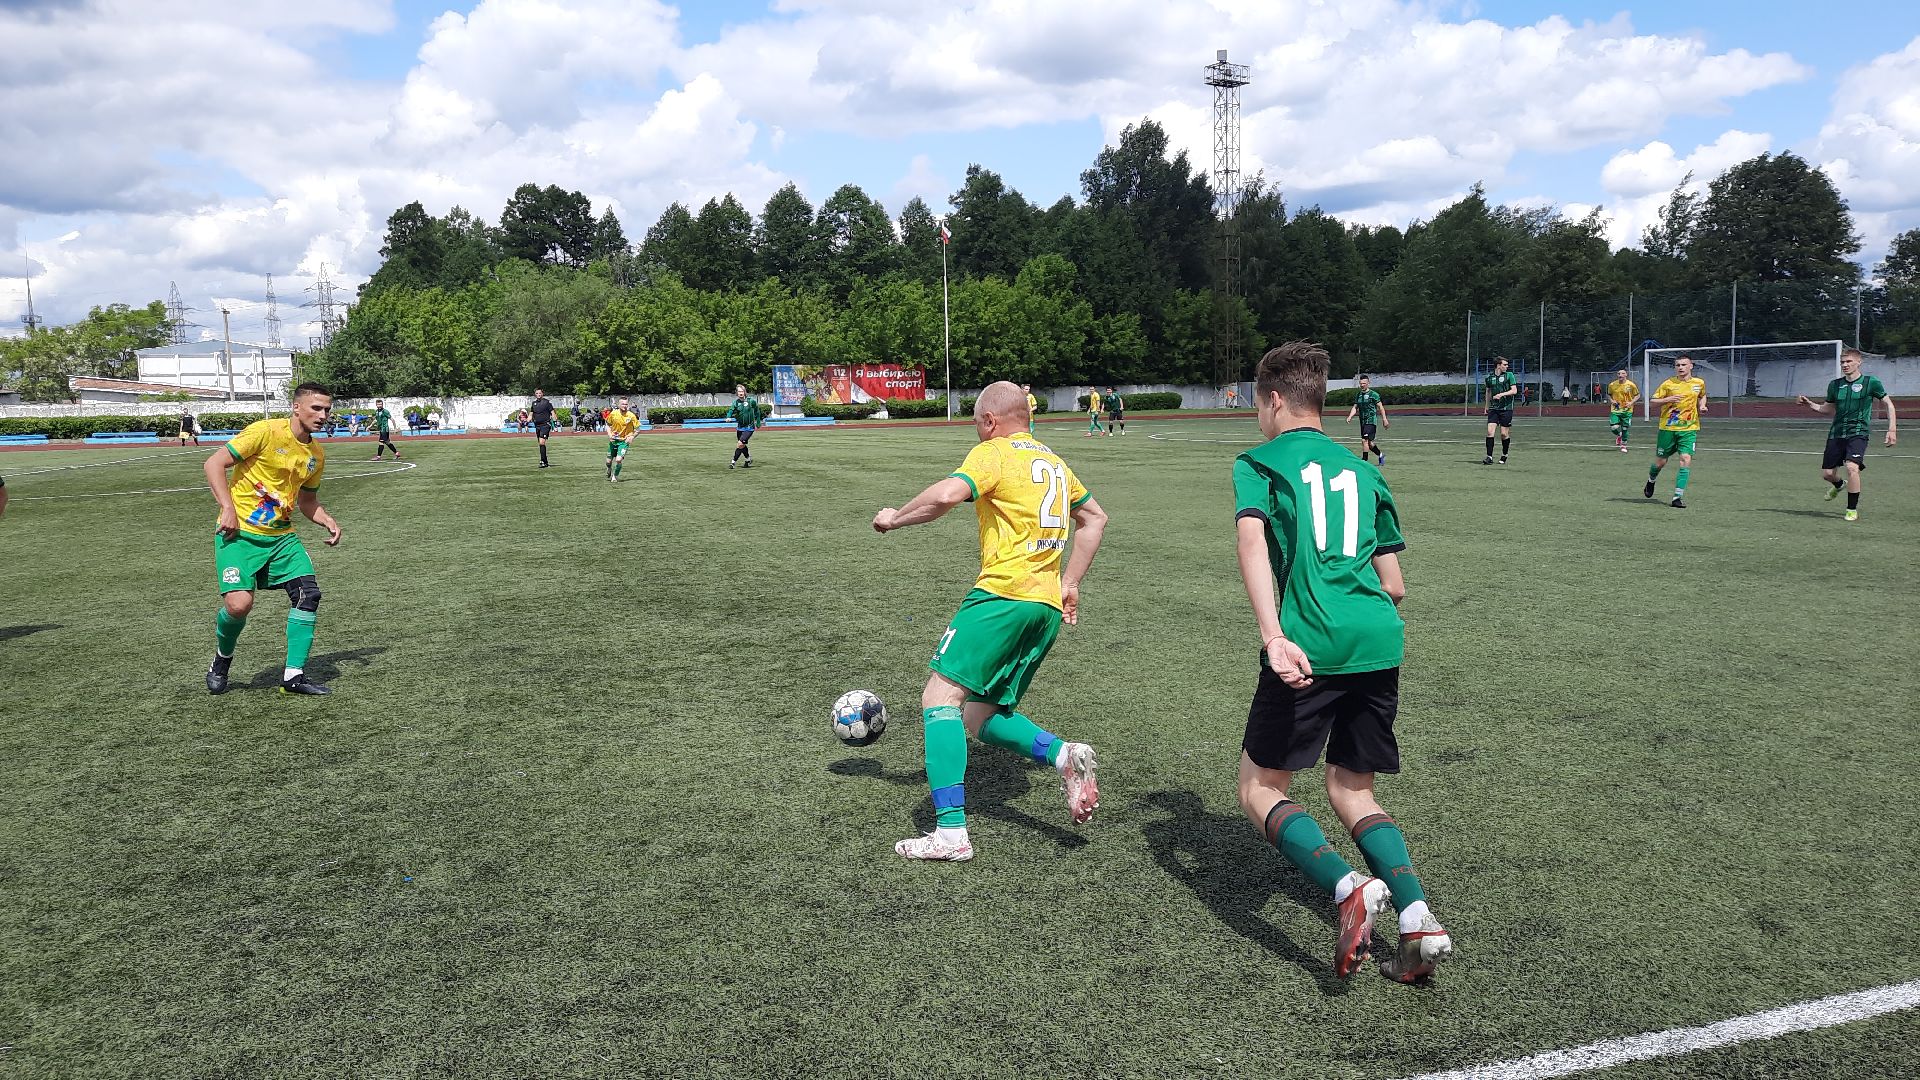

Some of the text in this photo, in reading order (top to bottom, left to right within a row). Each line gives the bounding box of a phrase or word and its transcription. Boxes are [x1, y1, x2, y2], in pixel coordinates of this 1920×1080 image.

[833, 367, 847, 376] 112
[856, 369, 864, 378] Я
[885, 379, 922, 390] спорт!
[1031, 458, 1069, 529] 21
[1300, 461, 1359, 558] 11
